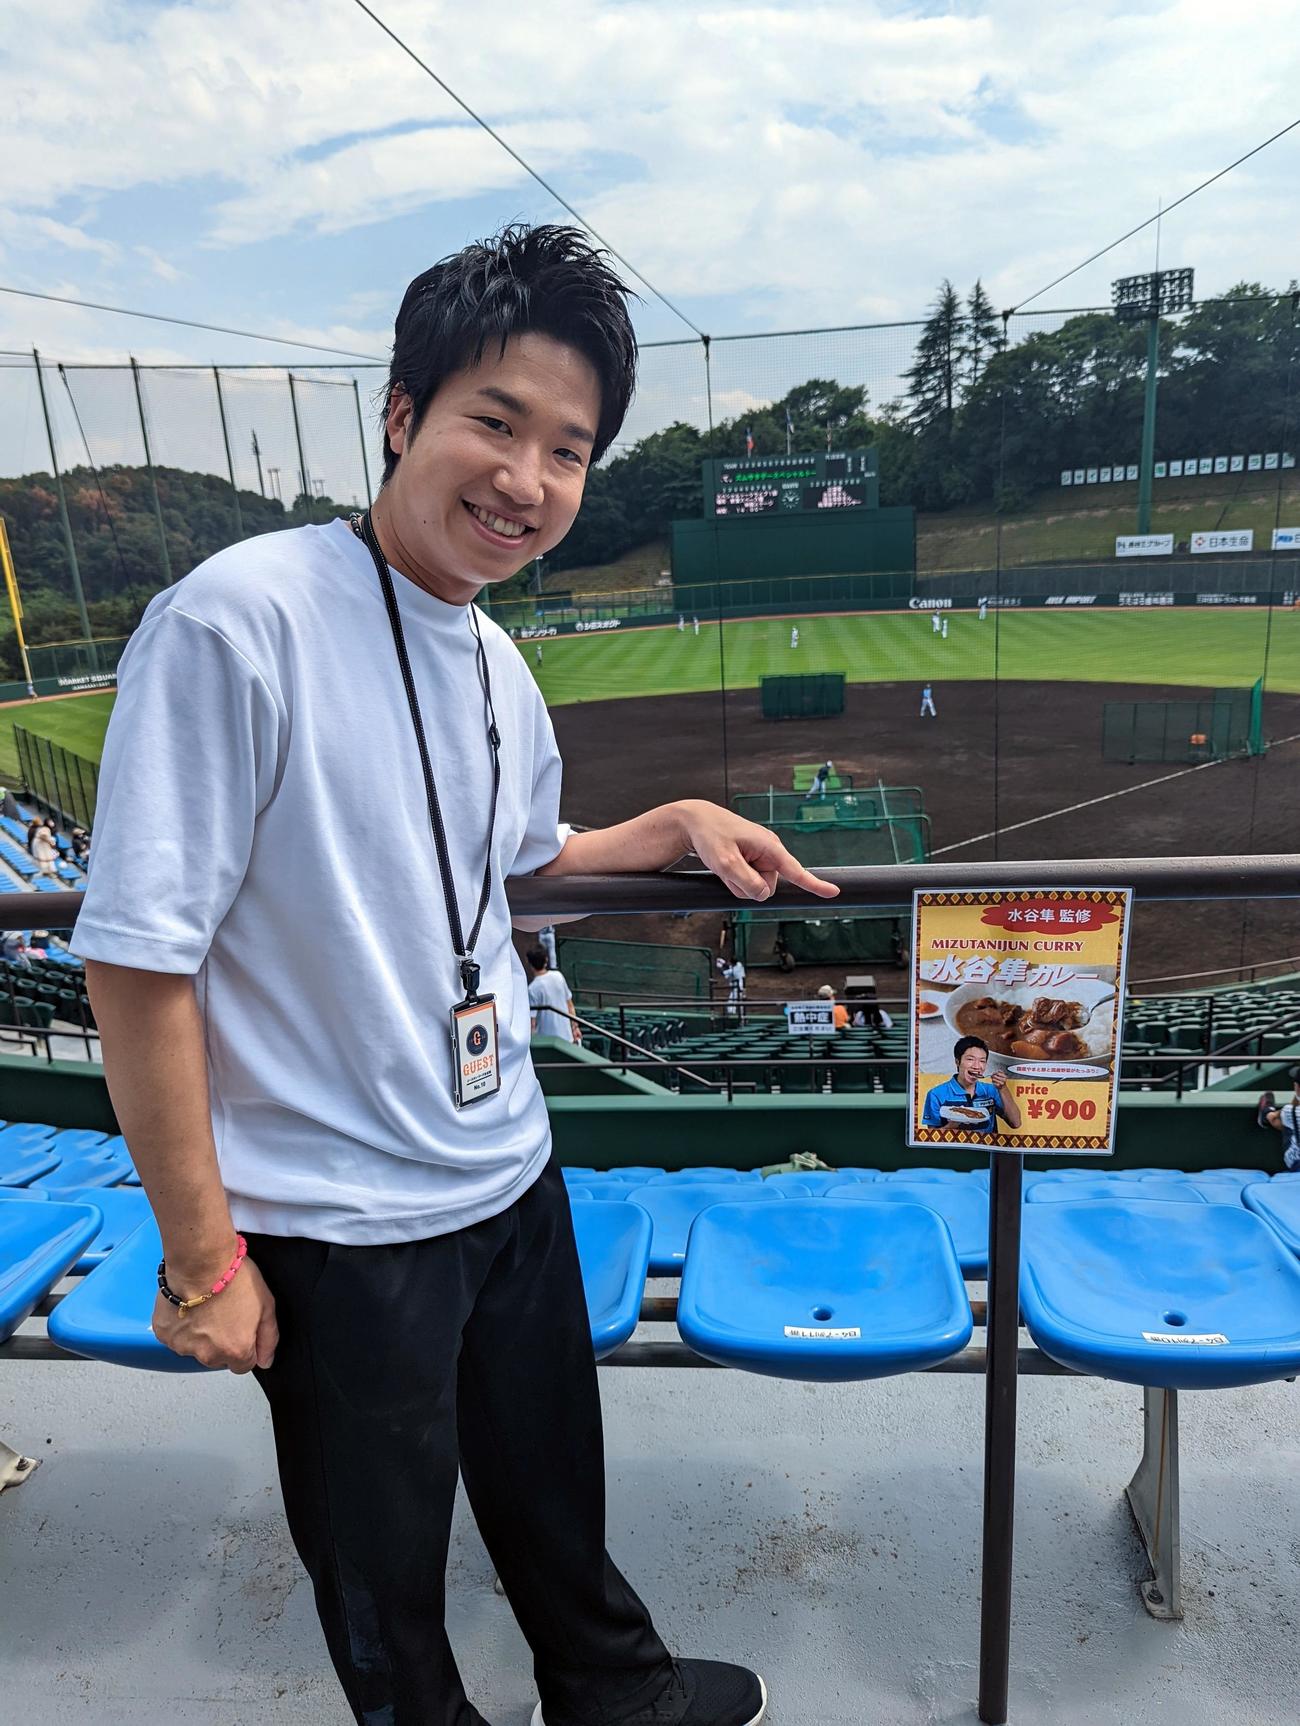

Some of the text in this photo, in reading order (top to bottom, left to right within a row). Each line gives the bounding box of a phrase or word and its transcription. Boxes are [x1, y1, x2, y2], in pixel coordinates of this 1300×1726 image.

[1209, 536, 1249, 547] 日本生命
[909, 597, 952, 609] Canon
[1007, 908, 1092, 923] 水谷隼 監修
[931, 938, 1084, 952] MIZUTANIJUN CURRY
[794, 1012, 830, 1023] 熱中症
[473, 1031, 481, 1045] G
[463, 1055, 495, 1077] GUEST
[1016, 1083, 1049, 1098] price
[1027, 1099, 1097, 1120] ¥900
